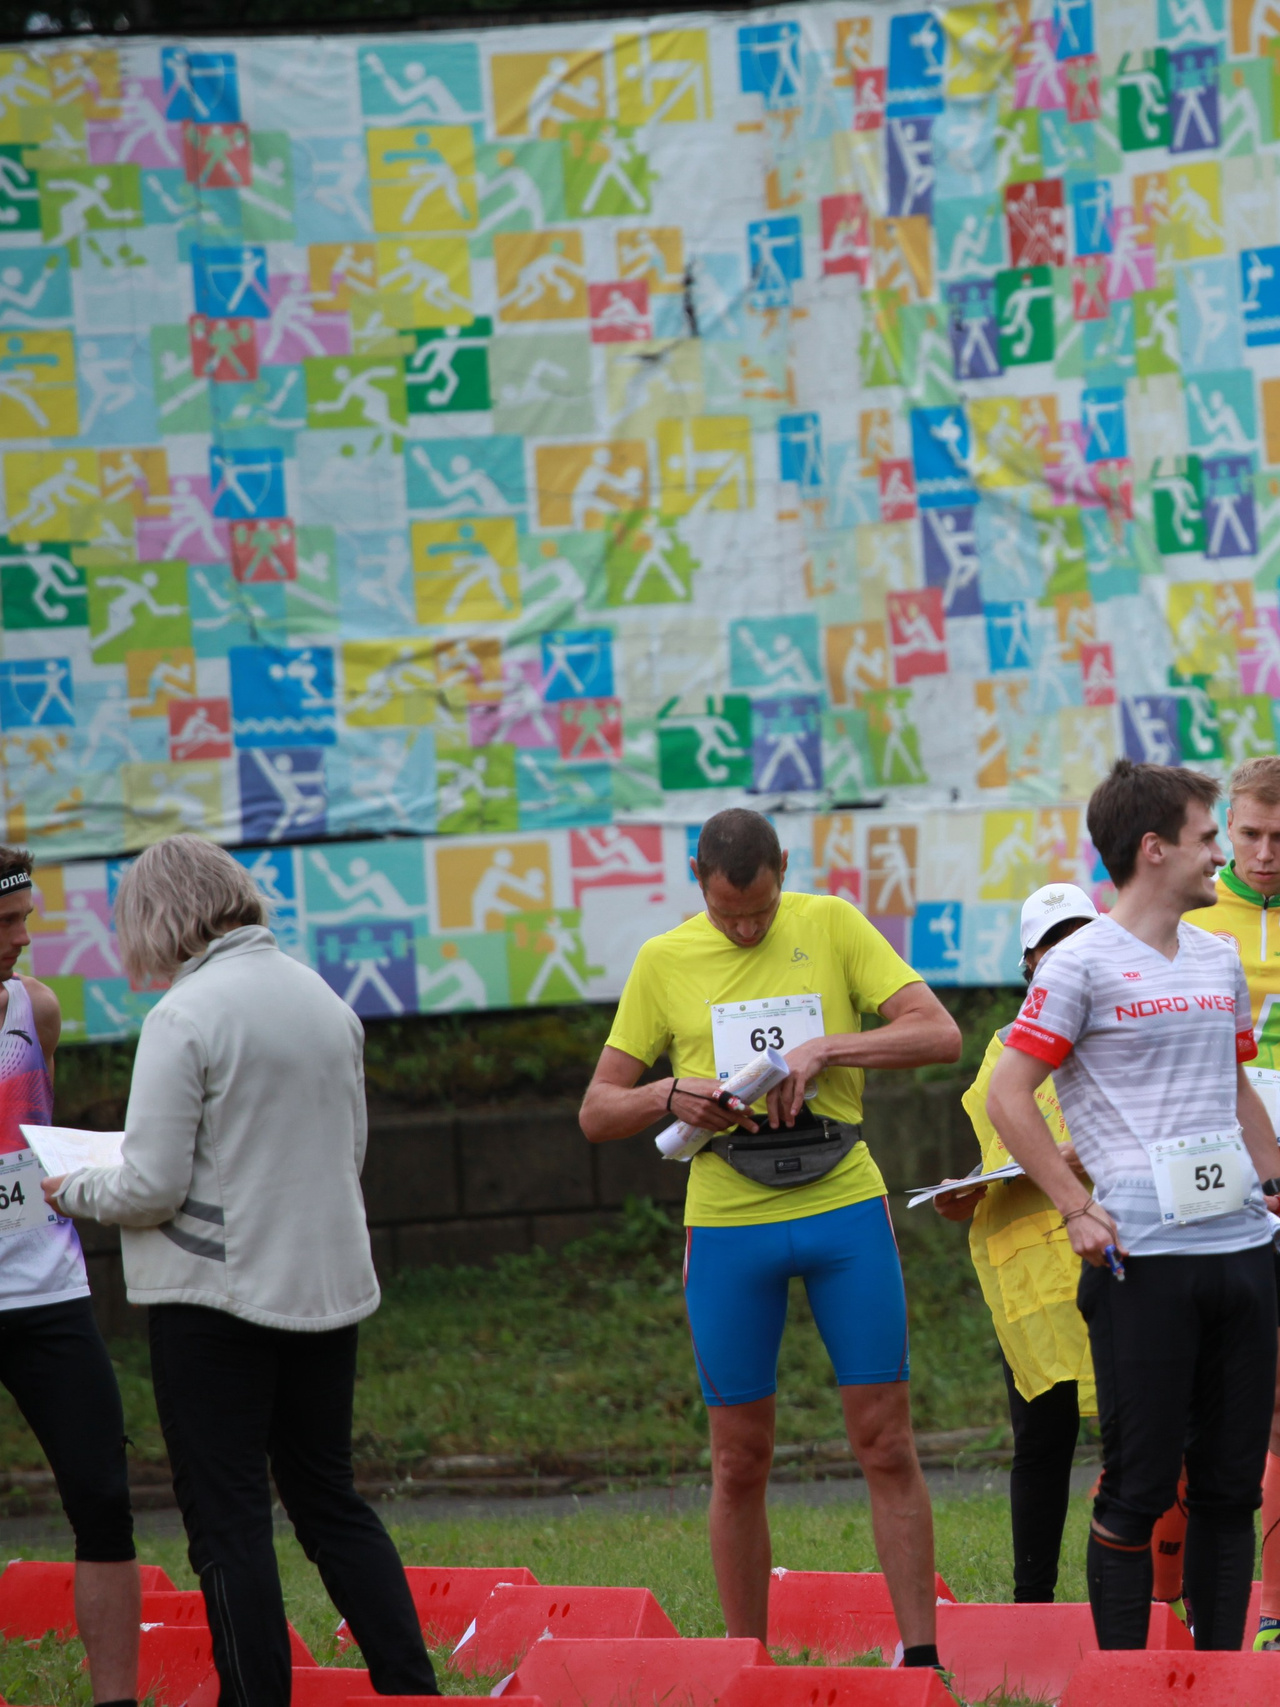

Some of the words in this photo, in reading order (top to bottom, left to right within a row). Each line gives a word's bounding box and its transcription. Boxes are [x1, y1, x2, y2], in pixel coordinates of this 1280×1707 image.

[1044, 902, 1072, 915] adidas
[1115, 996, 1189, 1022] NORD
[750, 1026, 785, 1052] 63
[1195, 1163, 1225, 1191] 52
[0, 1180, 25, 1210] 64
